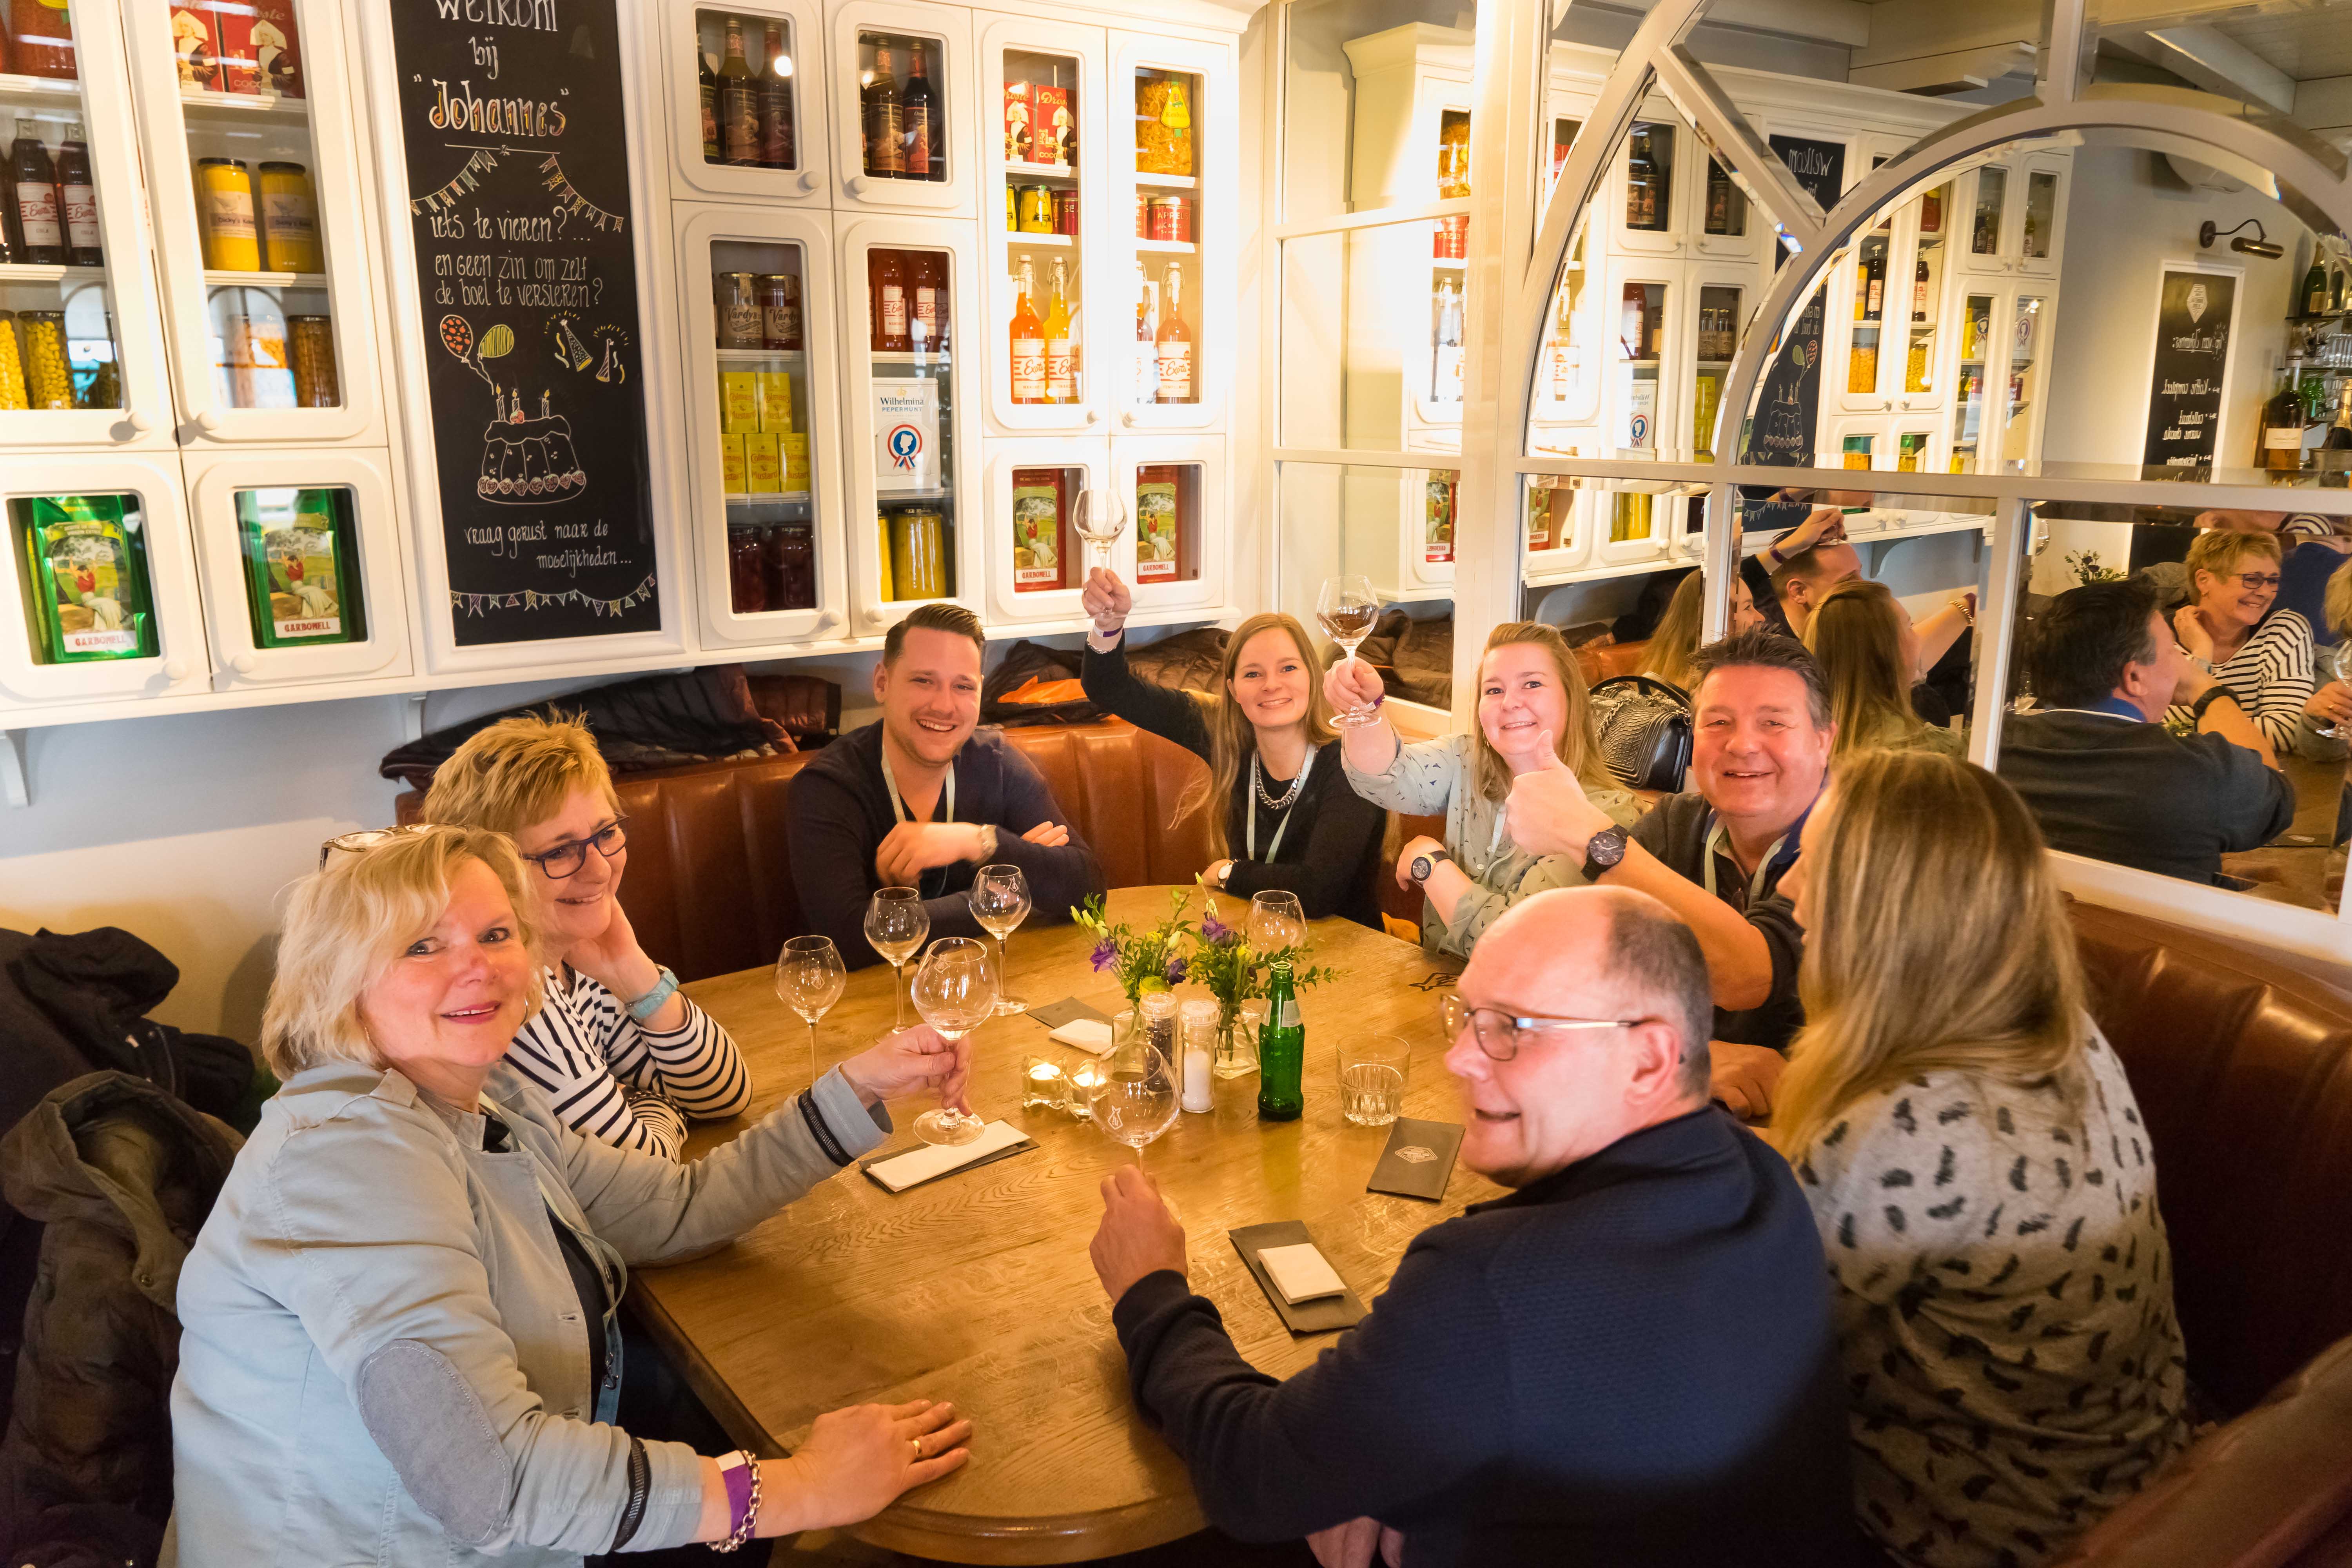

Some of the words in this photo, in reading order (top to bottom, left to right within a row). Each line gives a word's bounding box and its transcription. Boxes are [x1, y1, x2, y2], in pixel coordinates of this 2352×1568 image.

[468, 36, 499, 80] bij
[430, 207, 464, 239] iets
[474, 208, 492, 239] te
[435, 254, 452, 276] en
[499, 250, 527, 280] zin
[535, 258, 555, 280] om
[561, 256, 587, 281] zelf
[436, 280, 454, 305] de
[459, 278, 491, 306] boel
[496, 279, 512, 305] te
[1166, 360, 1187, 376] Exota
[880, 397, 924, 405] Wilhelmina
[464, 525, 503, 557] vraag
[554, 520, 588, 539] naar
[594, 519, 608, 537] de
